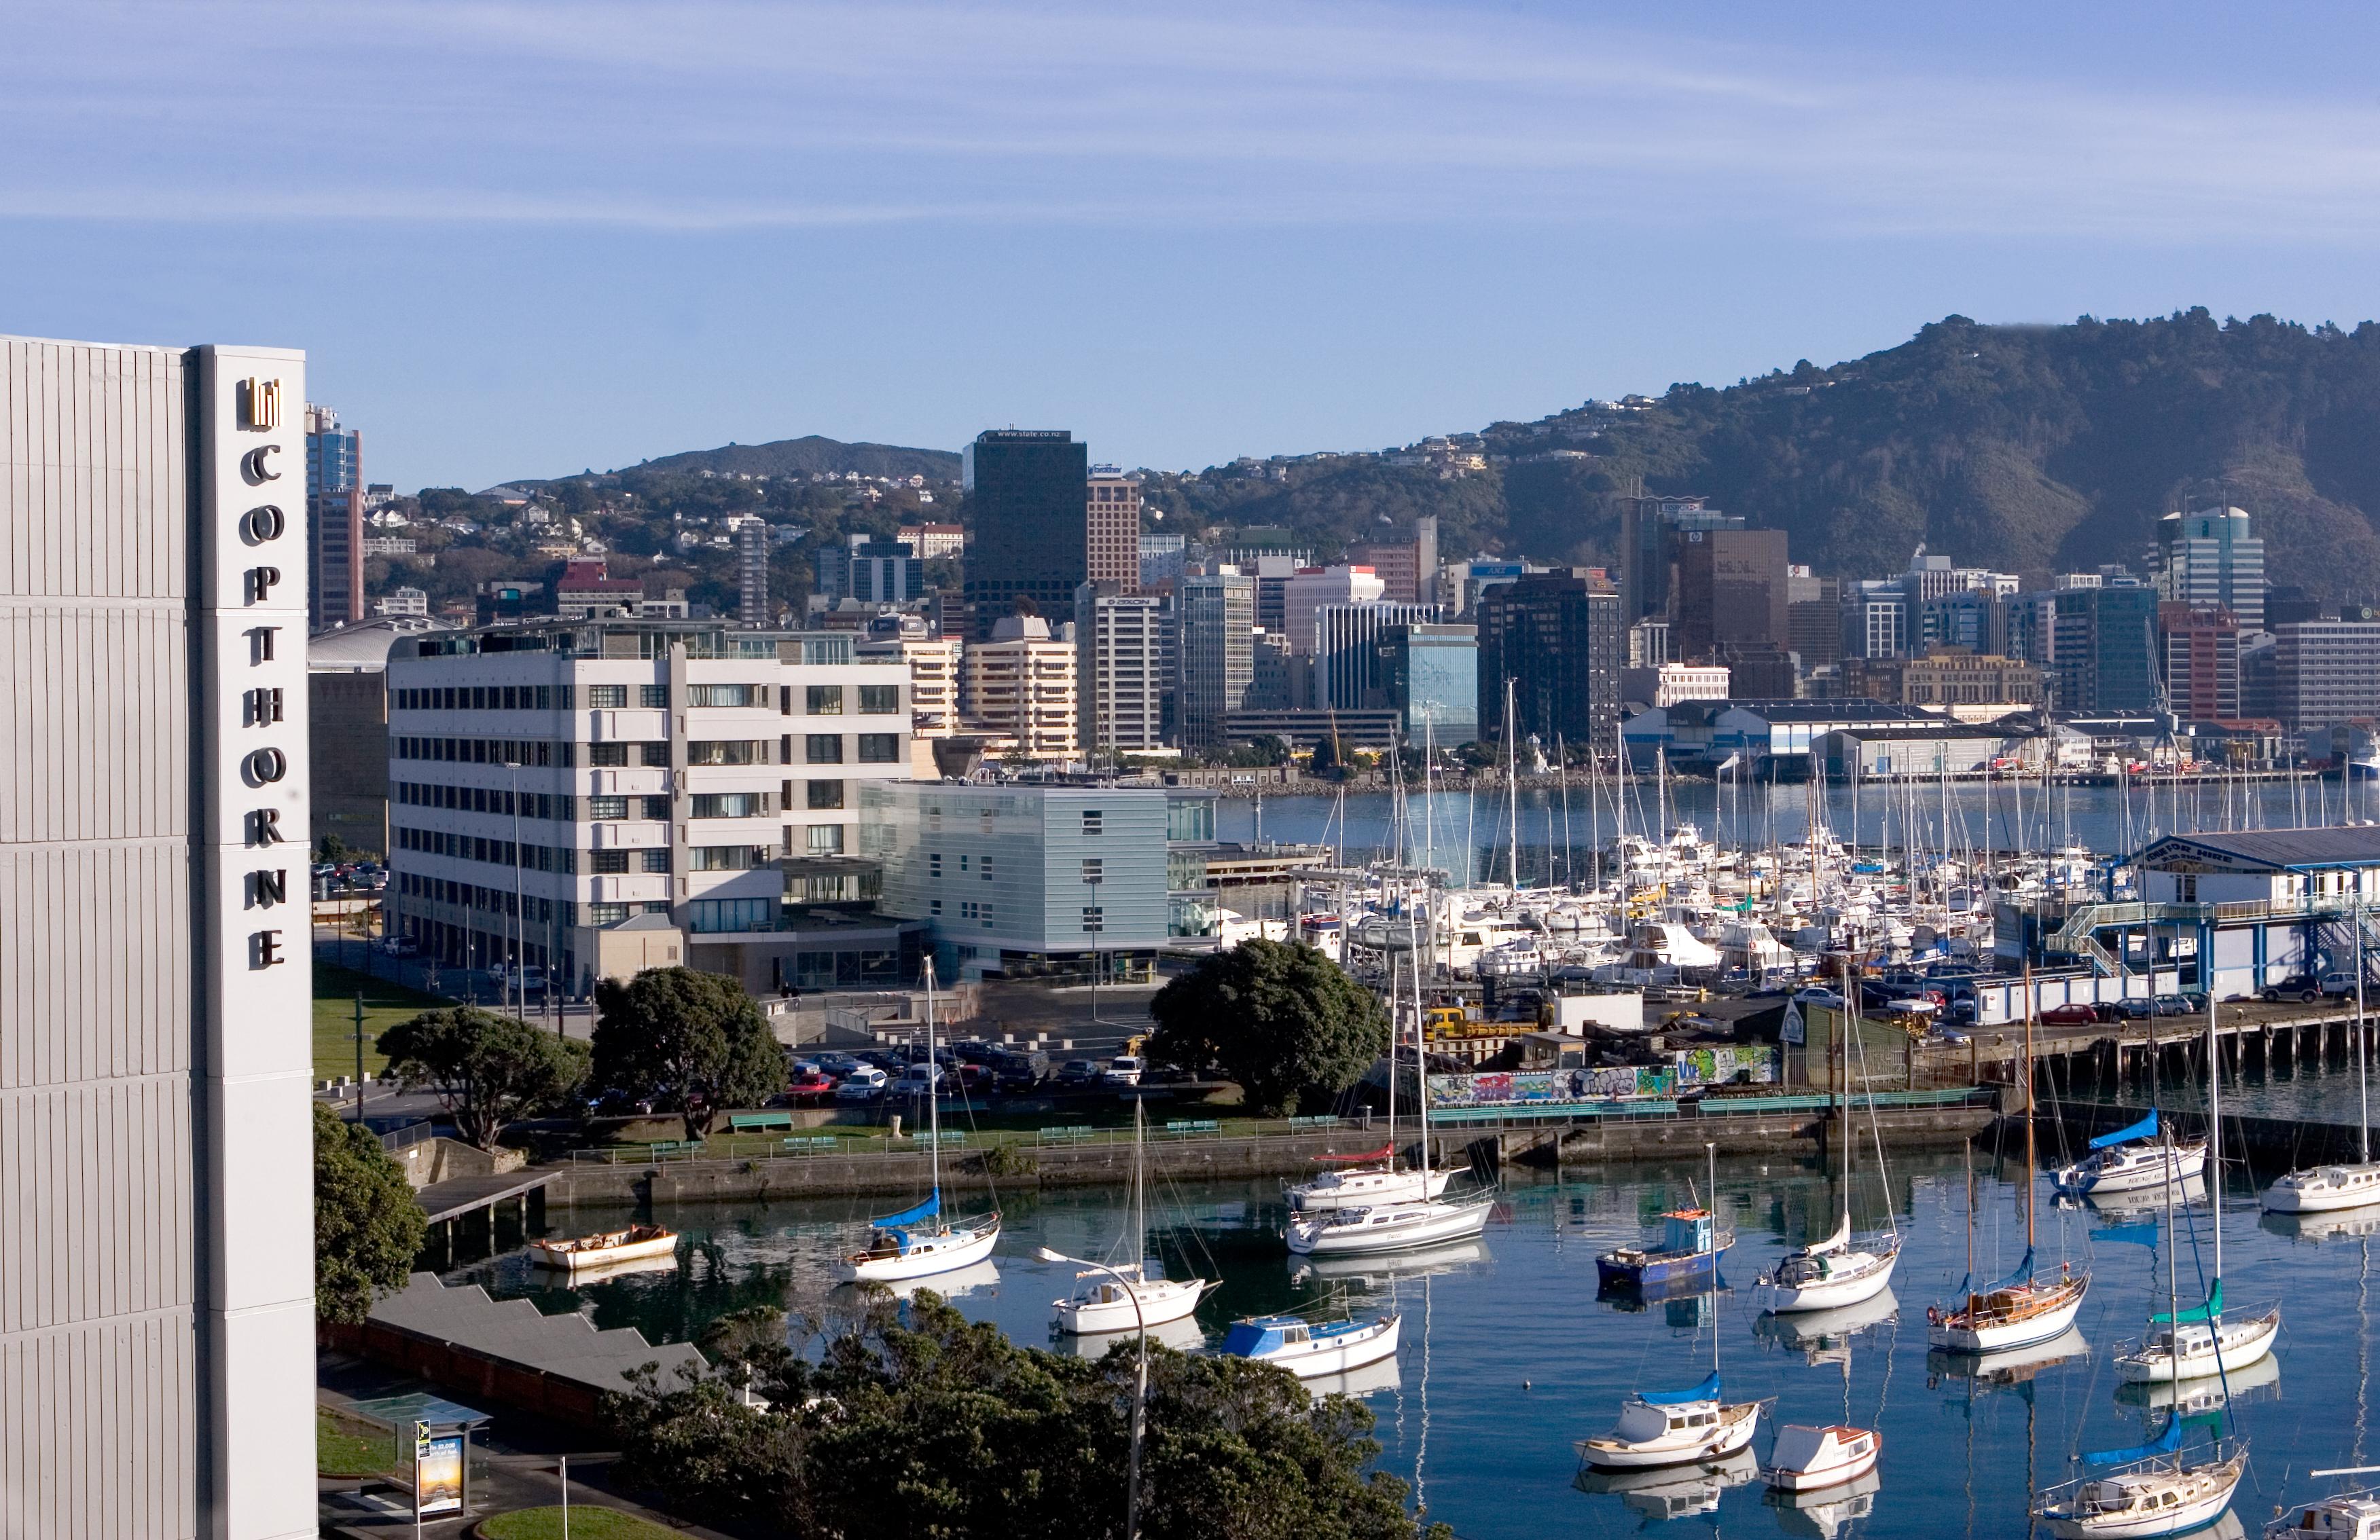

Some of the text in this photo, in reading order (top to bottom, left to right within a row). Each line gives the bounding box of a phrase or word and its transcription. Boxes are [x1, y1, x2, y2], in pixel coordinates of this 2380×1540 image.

[246, 445, 286, 964] COPTHORNE
[2144, 848, 2169, 862] VENUE
[2166, 843, 2192, 853] FOR
[2197, 849, 2233, 863] HIRE
